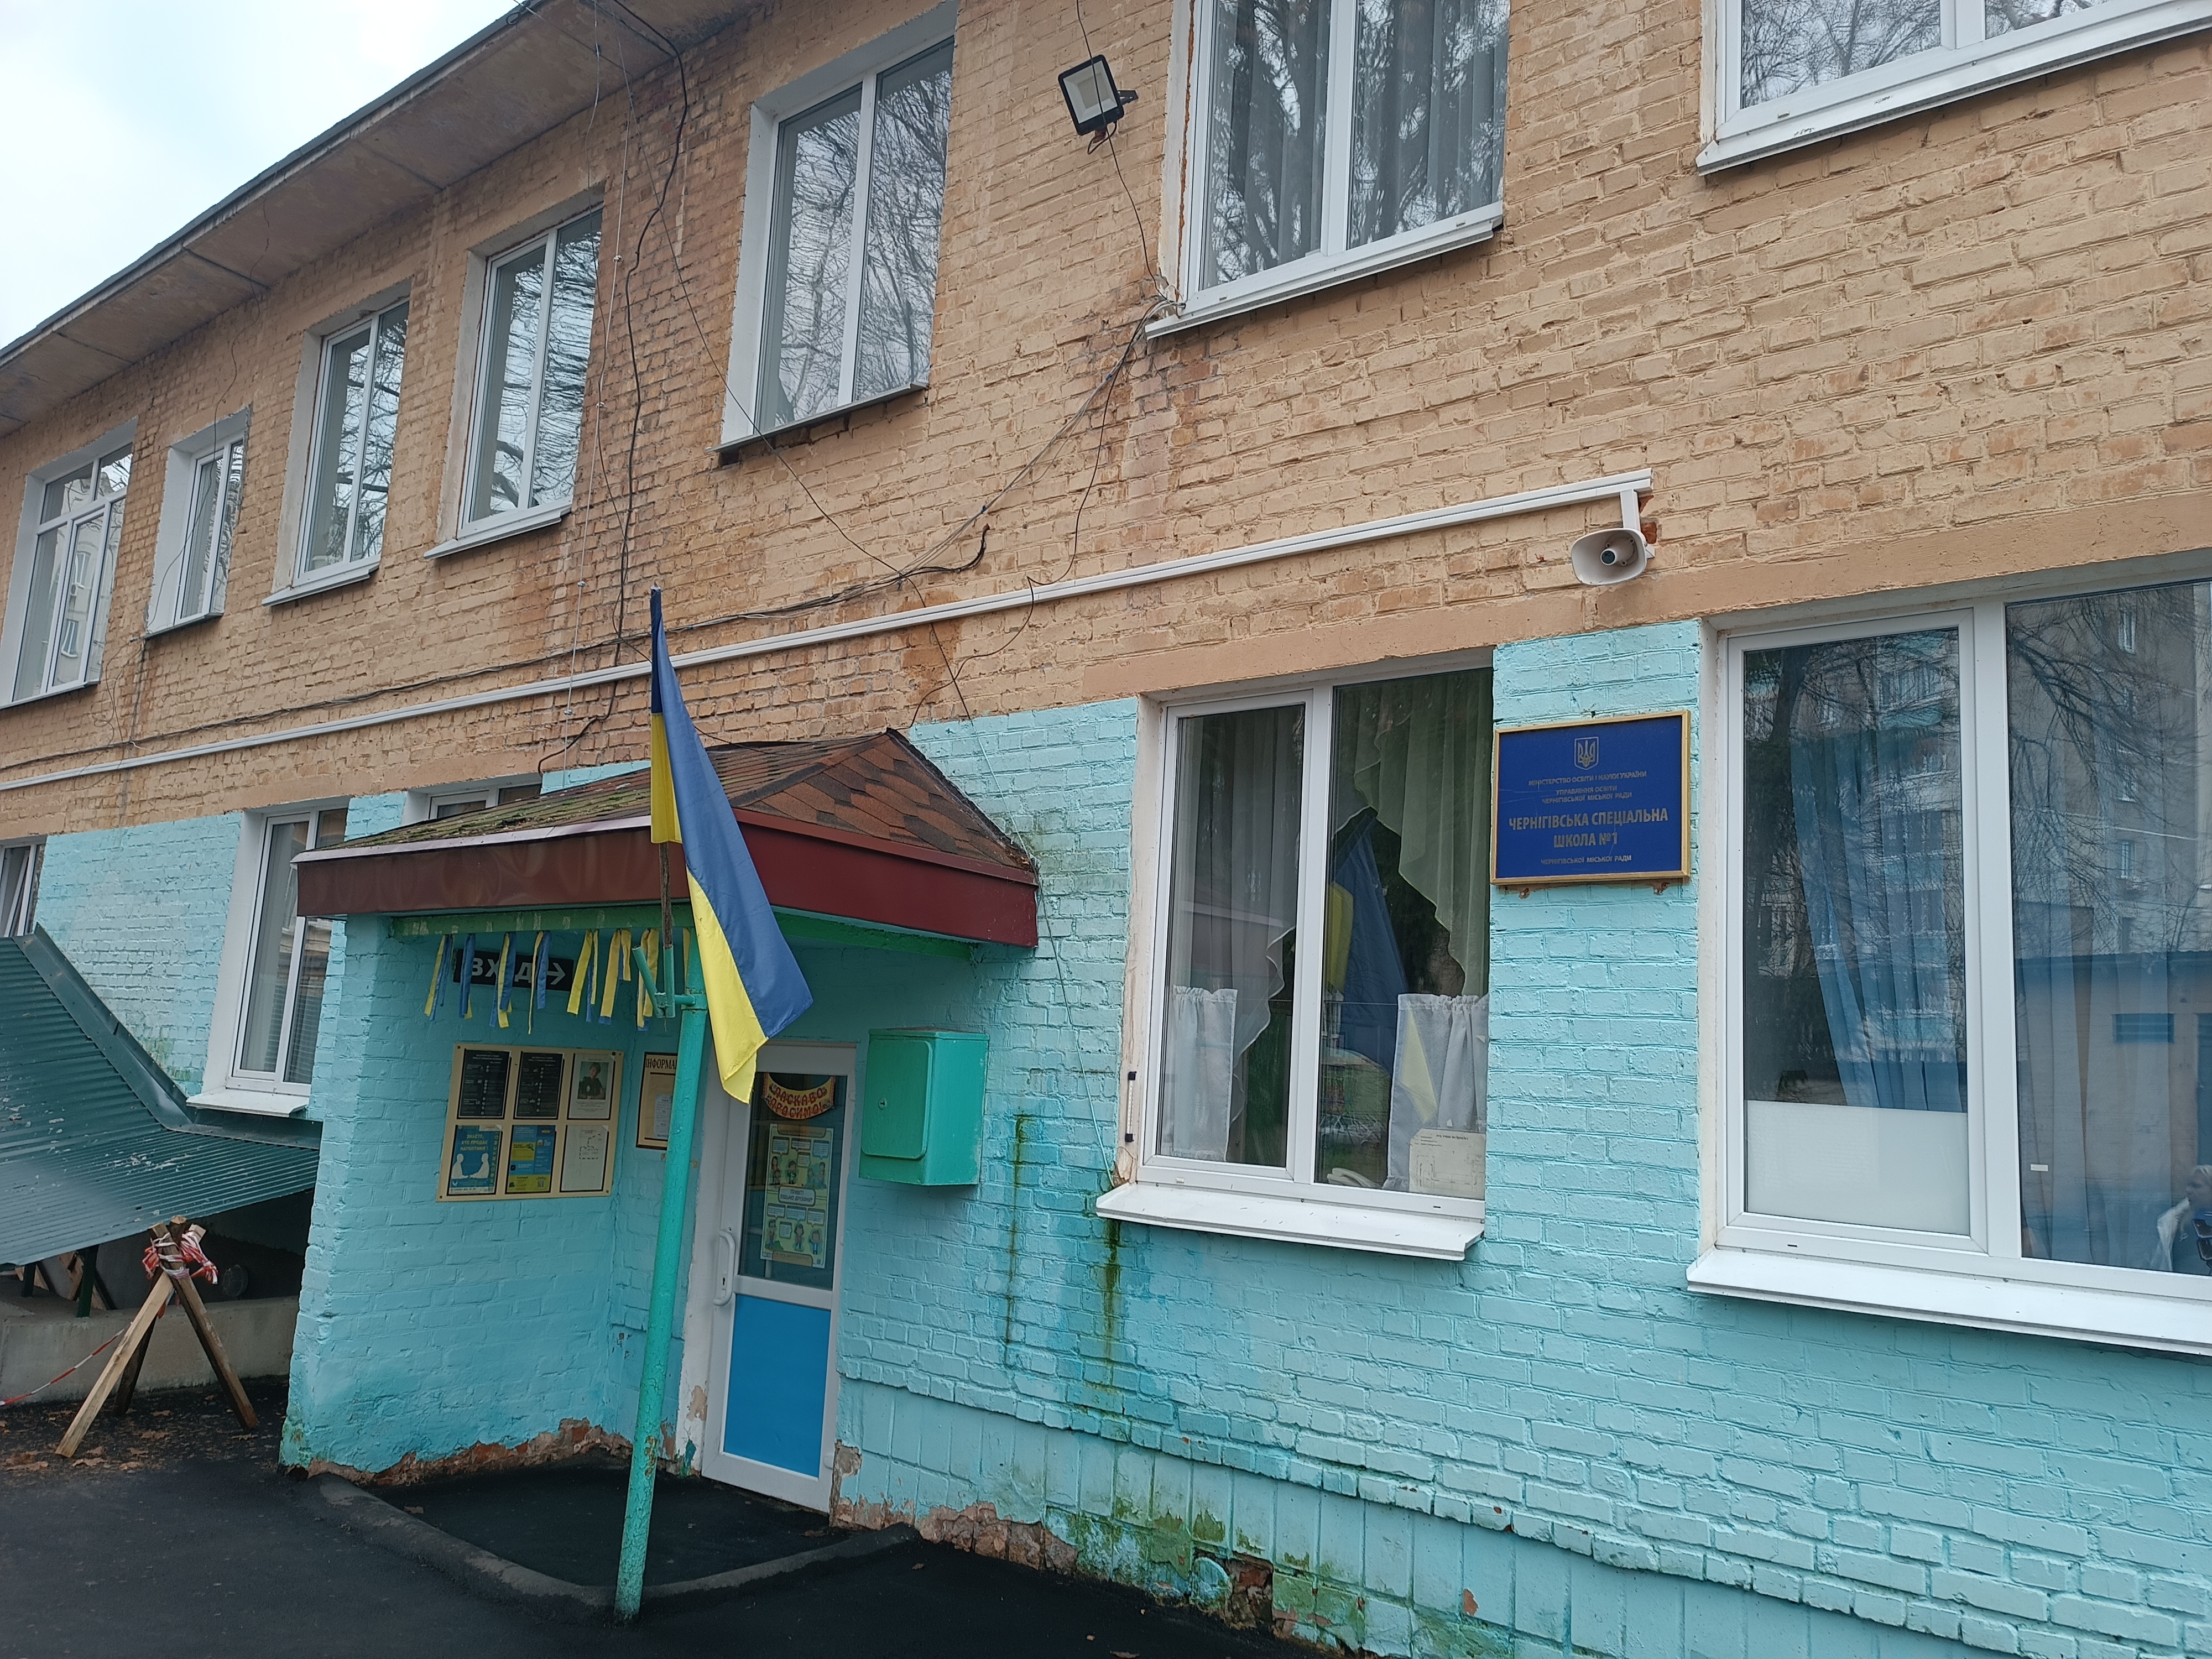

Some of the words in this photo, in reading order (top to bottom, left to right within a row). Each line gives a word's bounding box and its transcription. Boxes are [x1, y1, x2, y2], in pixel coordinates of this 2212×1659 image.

[1528, 778, 1571, 786] МІНІСТЕРСТВО
[1619, 771, 1647, 779] УКРАЇНИ
[1588, 793, 1613, 801] МІСЬКОЇ
[1509, 813, 1589, 831] ЧЕРНІГІВСЬКА
[1592, 807, 1668, 826] СПЕЦІАЛЬНА
[1553, 833, 1597, 848] ШКОЛА
[1599, 832, 1618, 846] №1
[471, 957, 533, 984] ВХД
[771, 1086, 823, 1107] ЛАСКАВО
